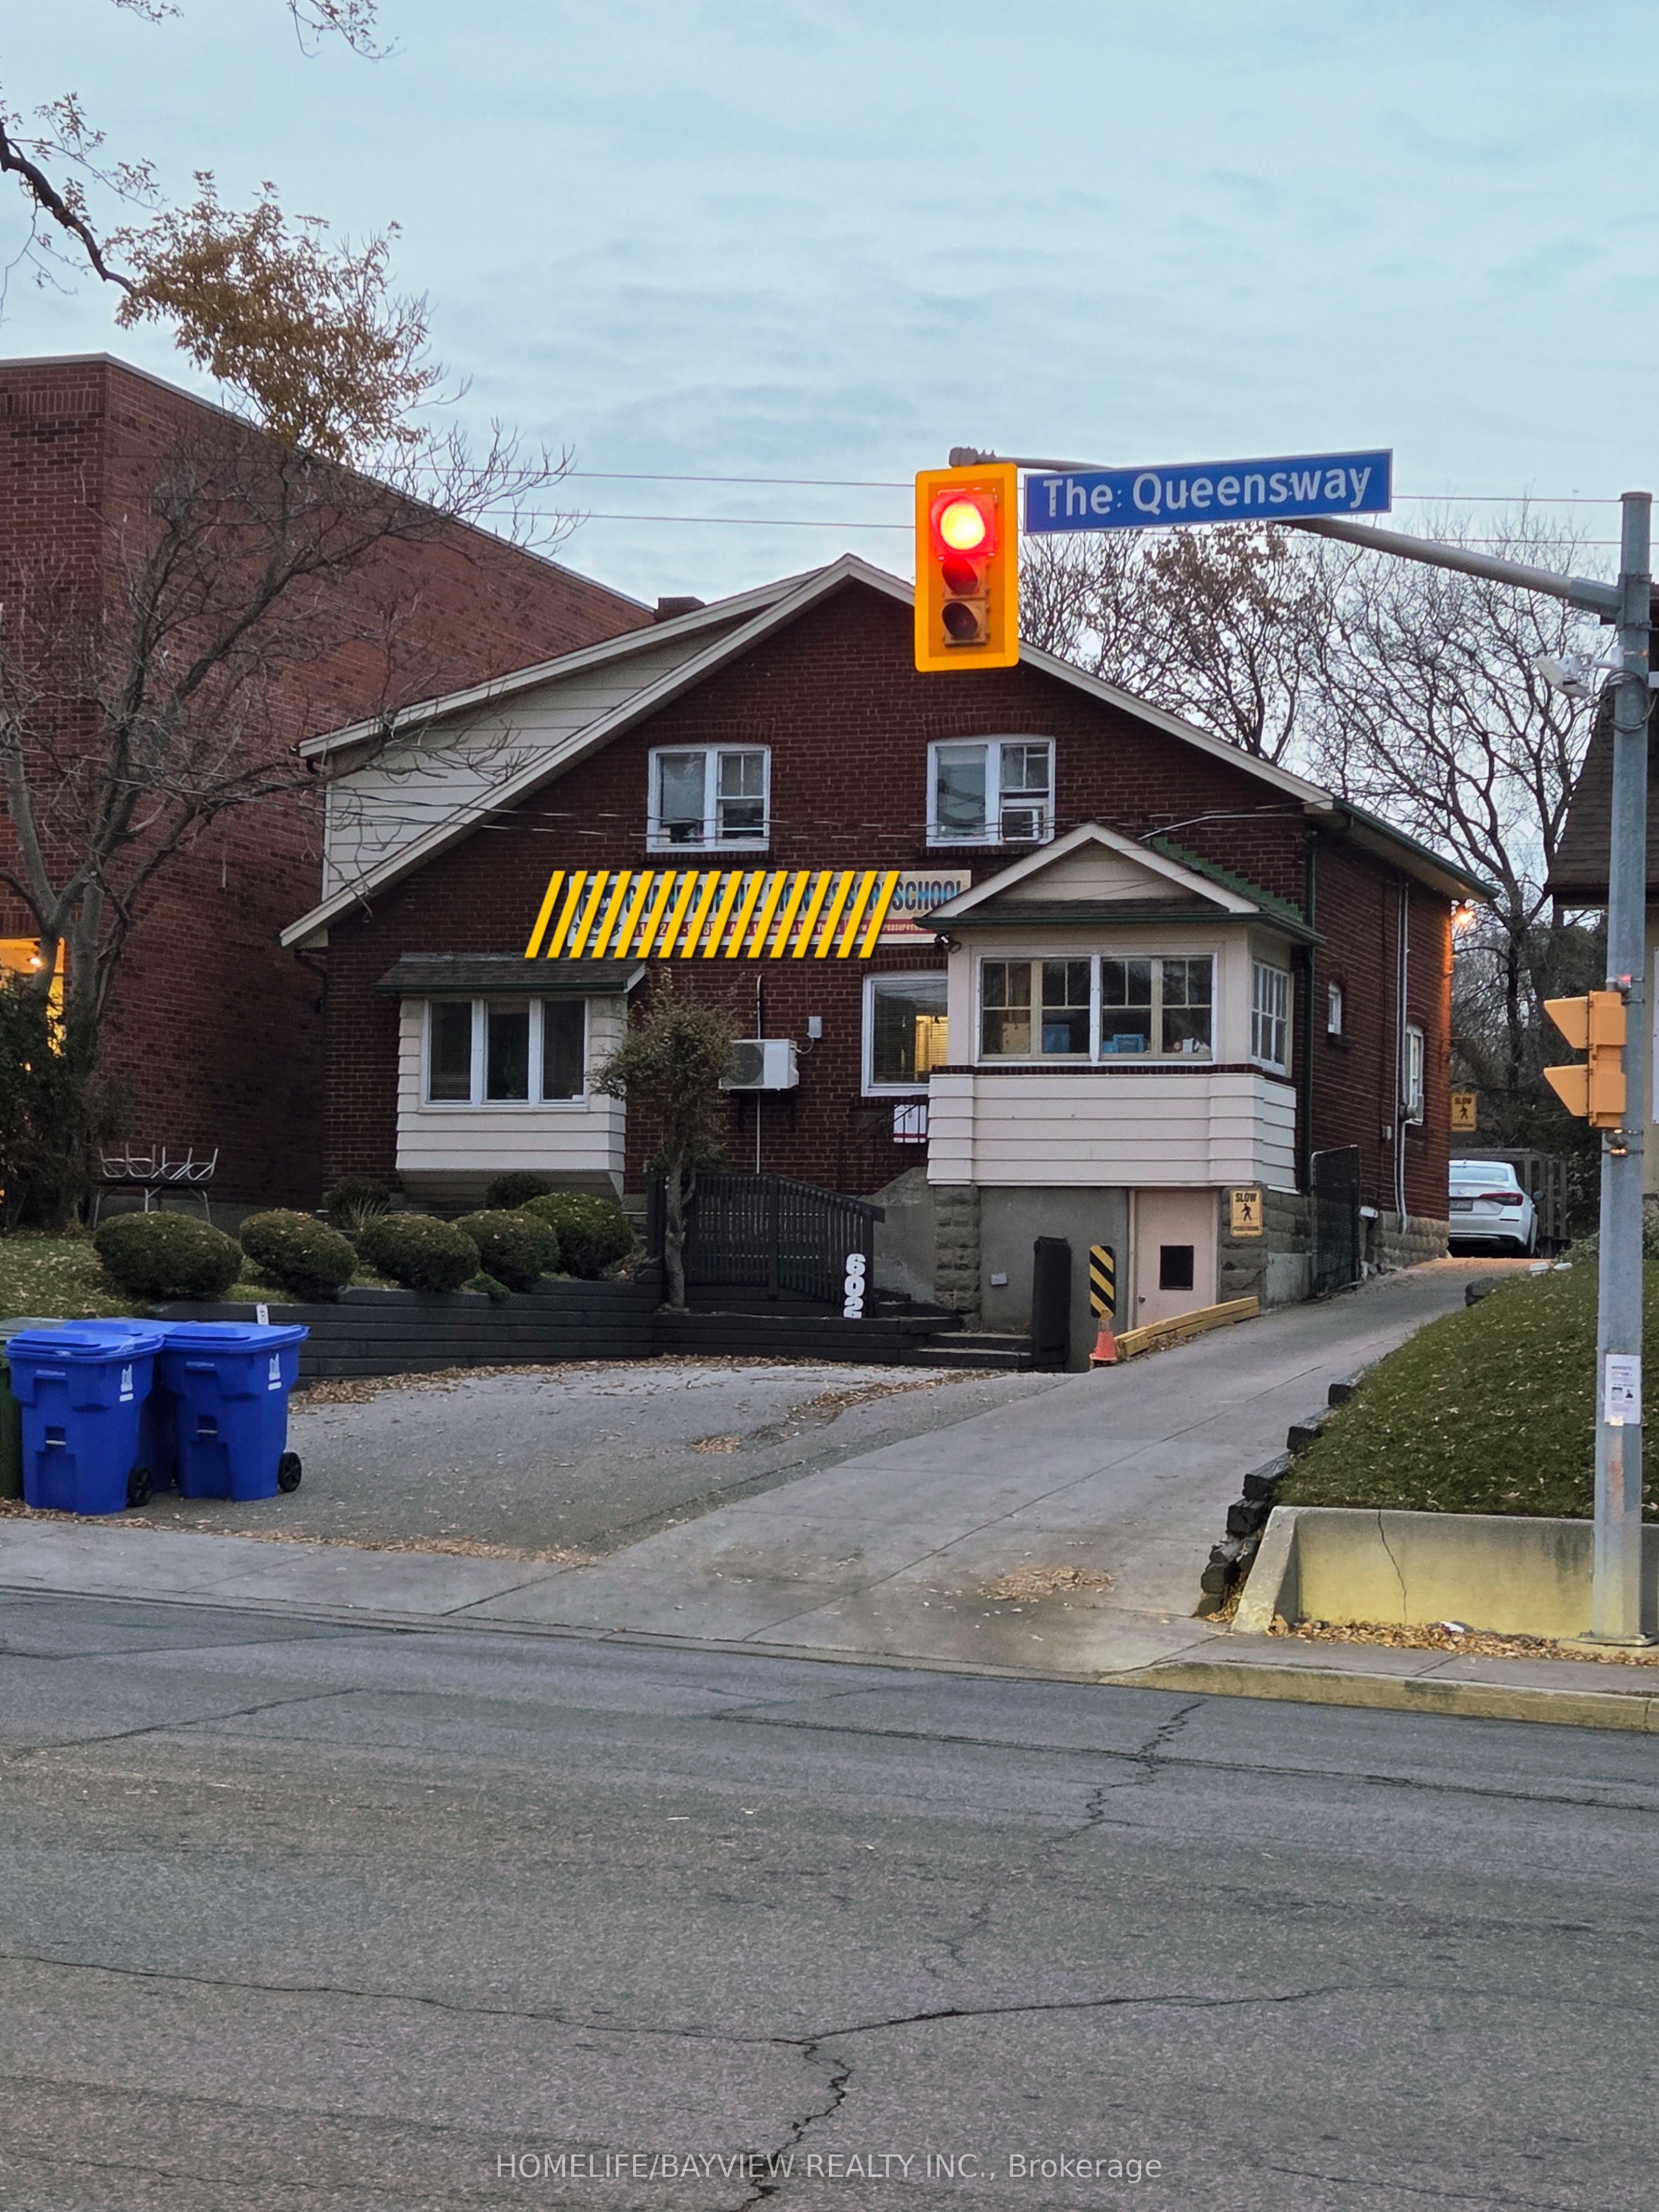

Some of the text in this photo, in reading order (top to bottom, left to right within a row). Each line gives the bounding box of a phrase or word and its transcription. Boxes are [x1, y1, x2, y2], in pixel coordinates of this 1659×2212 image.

[1043, 467, 1372, 517] The Queensway
[1235, 1192, 1257, 1203] SLOW
[843, 1253, 866, 1319] 602
